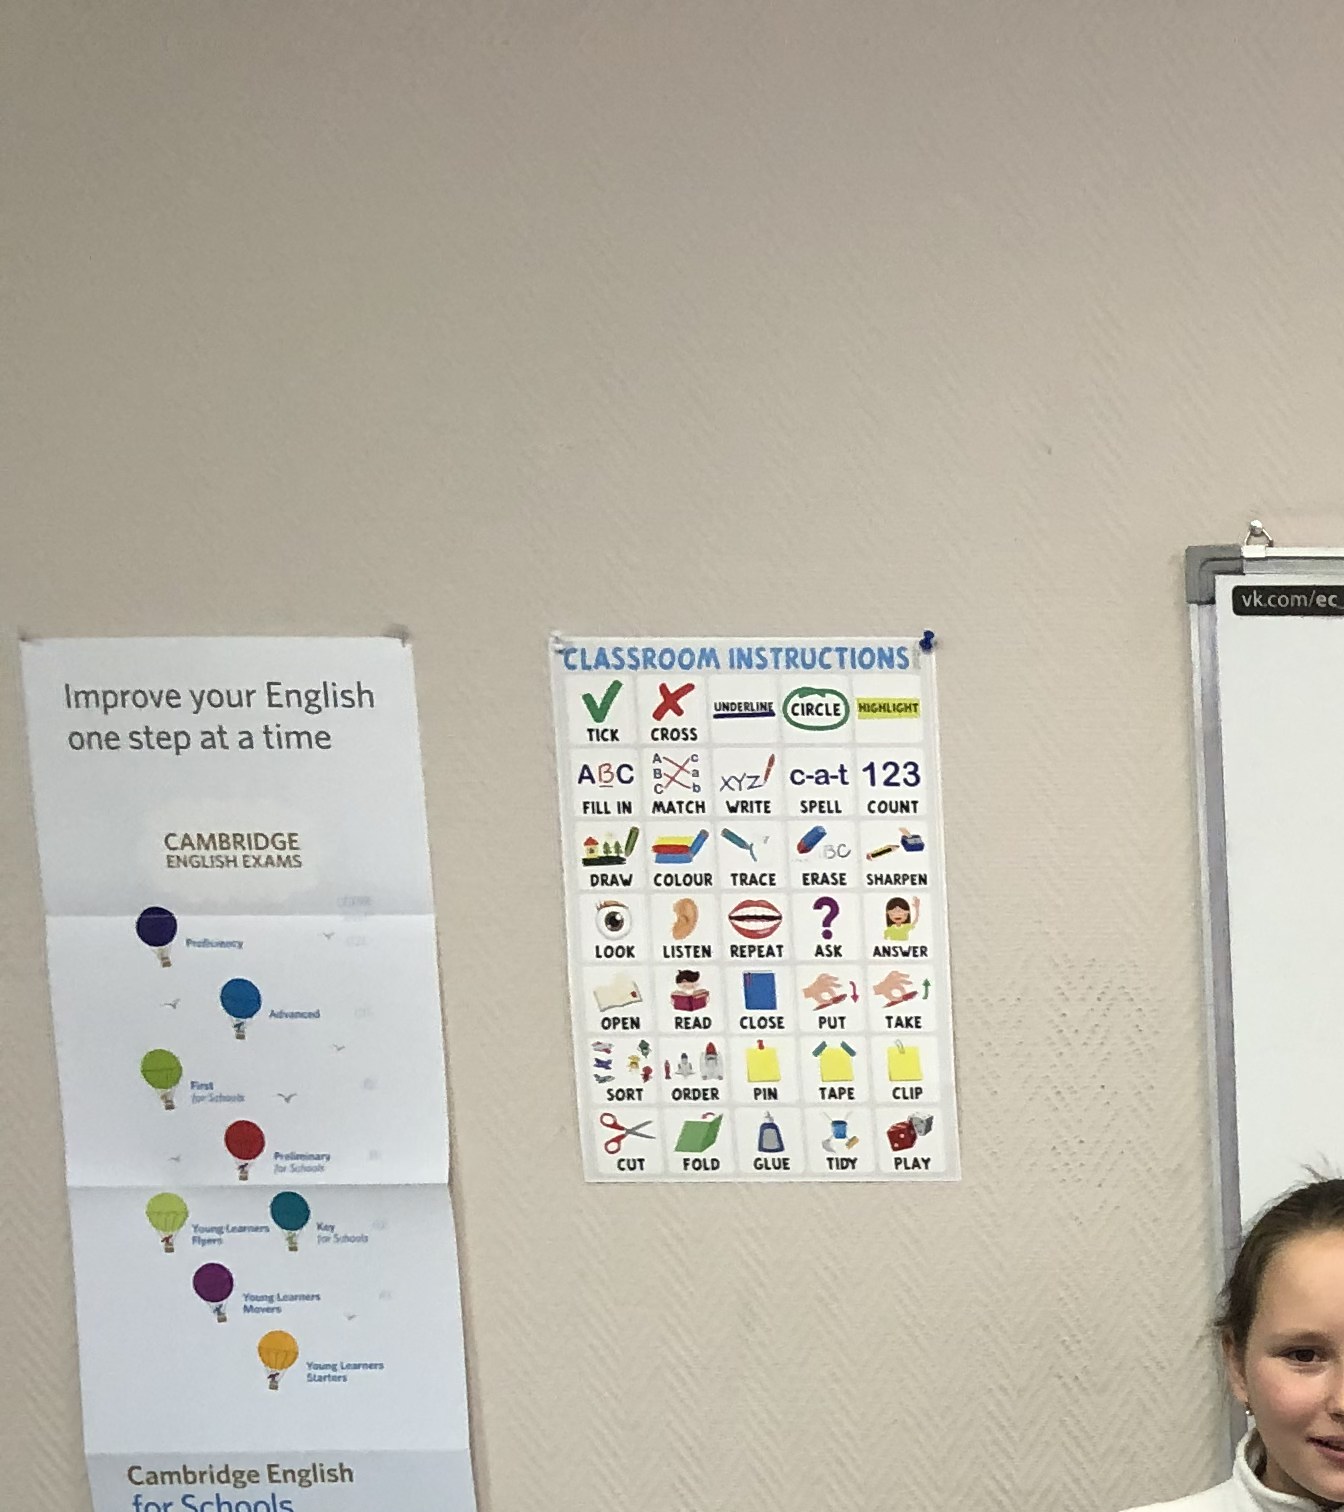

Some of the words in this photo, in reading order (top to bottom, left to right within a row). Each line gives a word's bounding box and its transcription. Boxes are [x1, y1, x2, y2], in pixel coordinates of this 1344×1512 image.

[564, 647, 719, 671] CLASSROOM
[729, 646, 909, 670] INSTRUCTIONS
[65, 682, 182, 714] Improve
[192, 687, 257, 714] your
[266, 681, 375, 715] English
[714, 702, 774, 713] UNDERLINE
[791, 703, 840, 717] CIRCLE
[858, 702, 919, 714] HIGHLIGHT
[68, 729, 120, 750] one
[129, 725, 191, 755] step
[200, 726, 230, 750] at
[238, 730, 255, 750] a
[262, 723, 332, 751] time
[587, 728, 620, 742] TICK
[651, 727, 698, 742] CROSS
[577, 763, 635, 788] ABC
[790, 764, 849, 786] c-a-t
[862, 761, 921, 787] 123
[719, 775, 764, 792] XYZ
[583, 801, 611, 815] FILL
[617, 801, 632, 815] IN
[651, 801, 706, 814] MATCH
[726, 800, 771, 814] WRITE
[800, 800, 842, 814] SPELL
[867, 800, 919, 814] COUNT
[164, 833, 299, 851] CAMBRIDGE
[167, 854, 238, 869] ENGLISH
[242, 854, 303, 869] EXAMS
[590, 874, 633, 887] DRAW
[654, 873, 713, 887] COLOUR
[731, 873, 777, 886] TRACE
[802, 873, 847, 886] ERASE
[866, 873, 928, 886] SHARPEN
[595, 945, 635, 959] LOOK
[663, 945, 712, 959] LISTEN
[730, 945, 784, 958] REPEAT
[814, 945, 843, 958] ASK
[873, 945, 928, 958] ANSWER
[269, 1009, 320, 1019] Advanced
[601, 1017, 641, 1030] OPEN
[674, 1017, 712, 1030] READ
[739, 1016, 784, 1030] CLOSE
[819, 1017, 845, 1030] PUT
[885, 1016, 922, 1029] TAKE
[607, 1088, 643, 1101] SORT
[671, 1088, 720, 1101] ORDER
[754, 1088, 778, 1101] PIN
[819, 1087, 855, 1101] TAPE
[892, 1087, 923, 1101] CLIP
[617, 1158, 645, 1171] CUT
[683, 1158, 720, 1171] FOLD
[753, 1158, 791, 1171] GLUE
[827, 1158, 857, 1170] TIDY
[894, 1158, 931, 1171] PLAY
[128, 1465, 260, 1489] Cambridge
[267, 1462, 354, 1488] English
